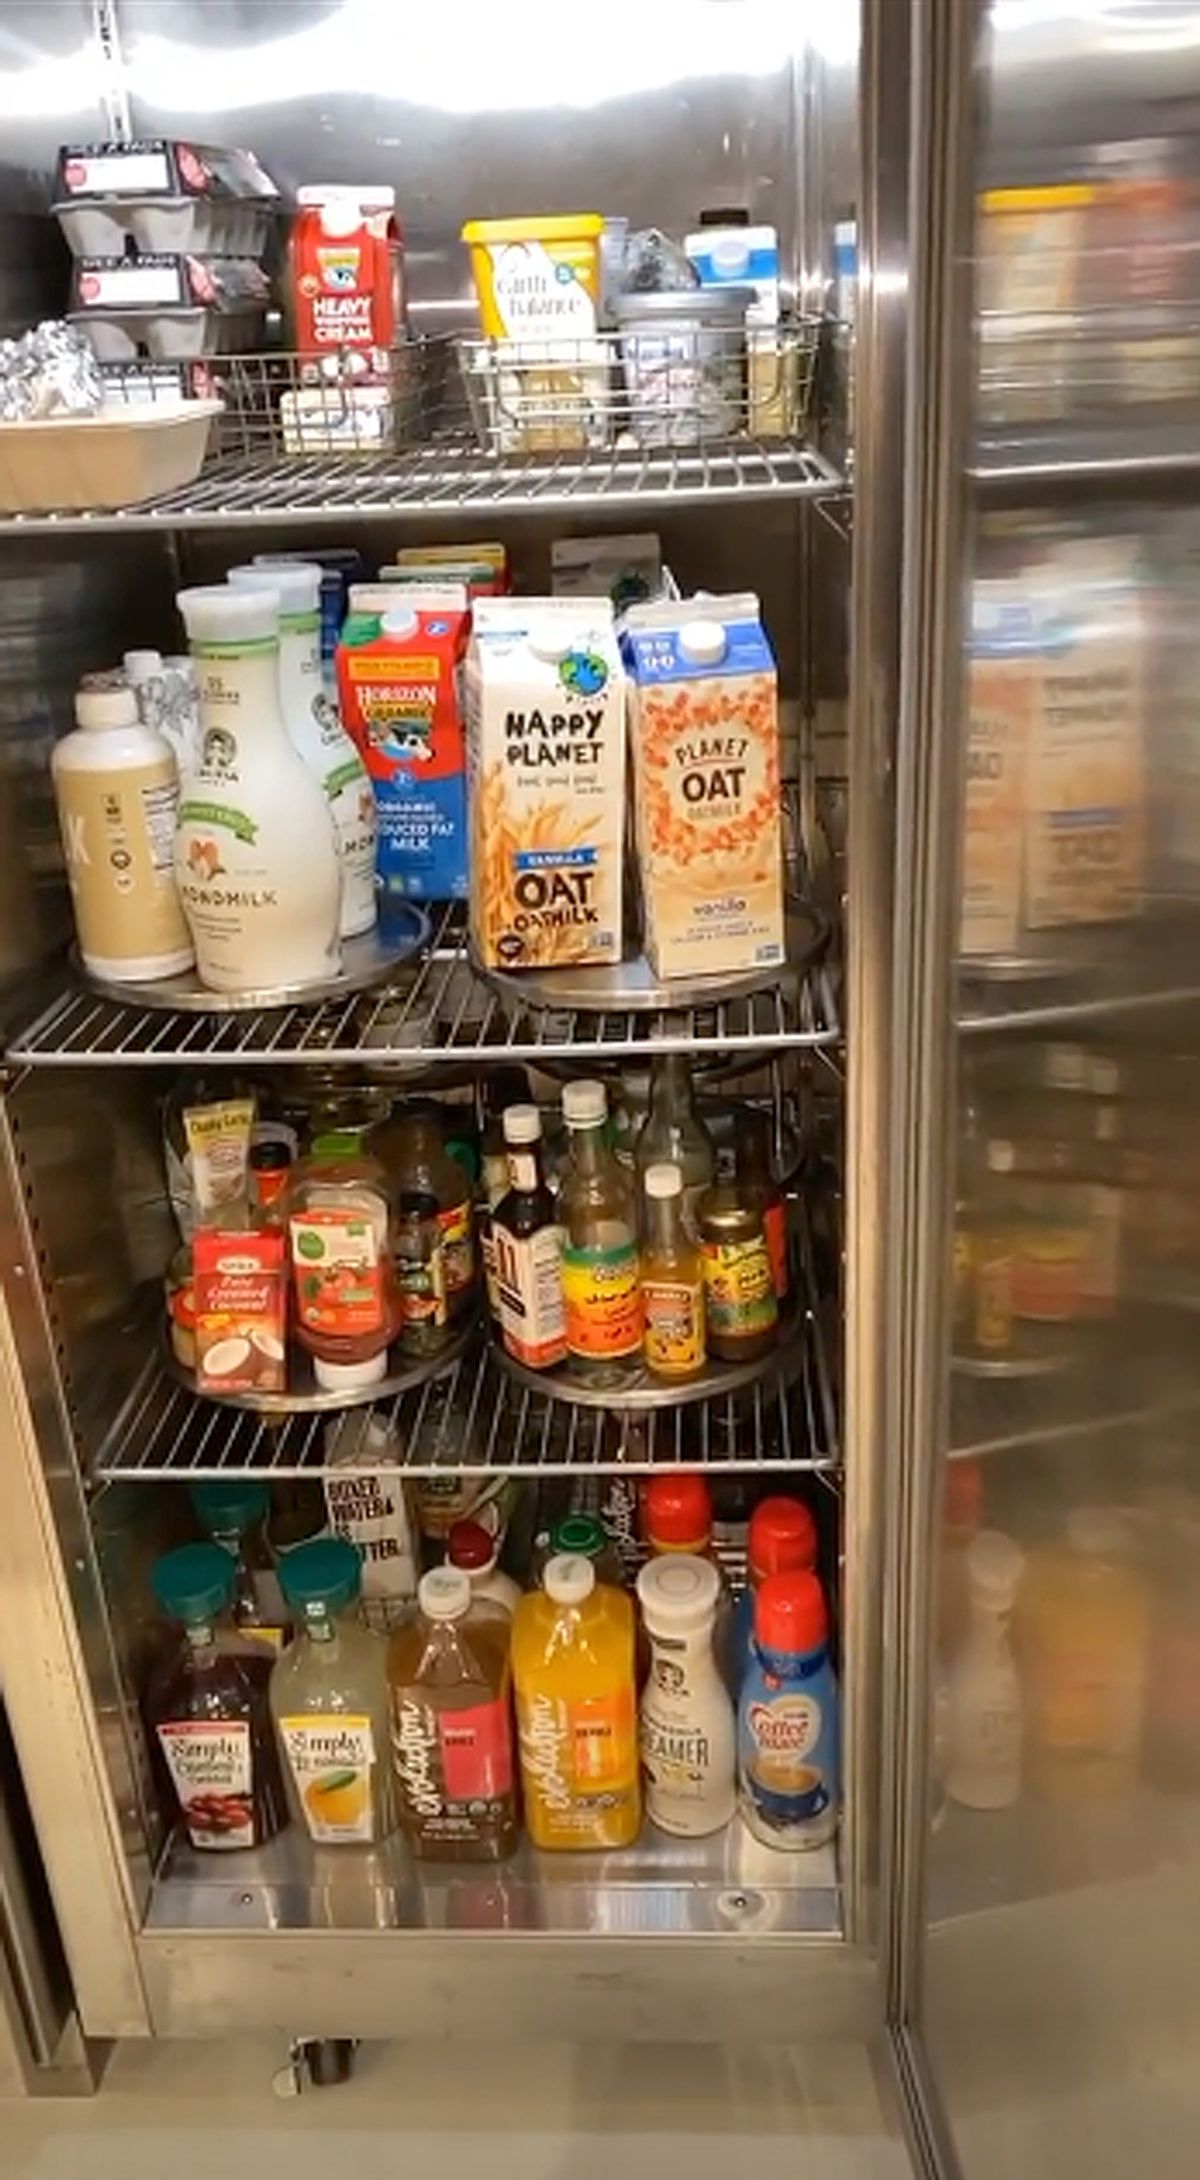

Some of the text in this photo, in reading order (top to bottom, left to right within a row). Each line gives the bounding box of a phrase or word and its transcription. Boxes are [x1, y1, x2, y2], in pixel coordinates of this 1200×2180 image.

[313, 297, 372, 316] HEAVY
[313, 325, 373, 342] CREAM
[355, 686, 437, 706] HORIZON
[506, 709, 604, 739] HAPPY
[507, 741, 604, 767] PLANET
[675, 738, 749, 766] PLANET
[682, 767, 746, 803] OAT
[381, 821, 456, 837] DUCED FAT
[390, 837, 433, 852] MILK
[515, 871, 595, 909] OAT
[513, 906, 599, 932] OATMILK
[332, 1498, 384, 1522] WATER
[170, 1738, 243, 1761] Simply
[288, 1730, 363, 1760] Simply
[647, 1733, 709, 1767] EAMER
